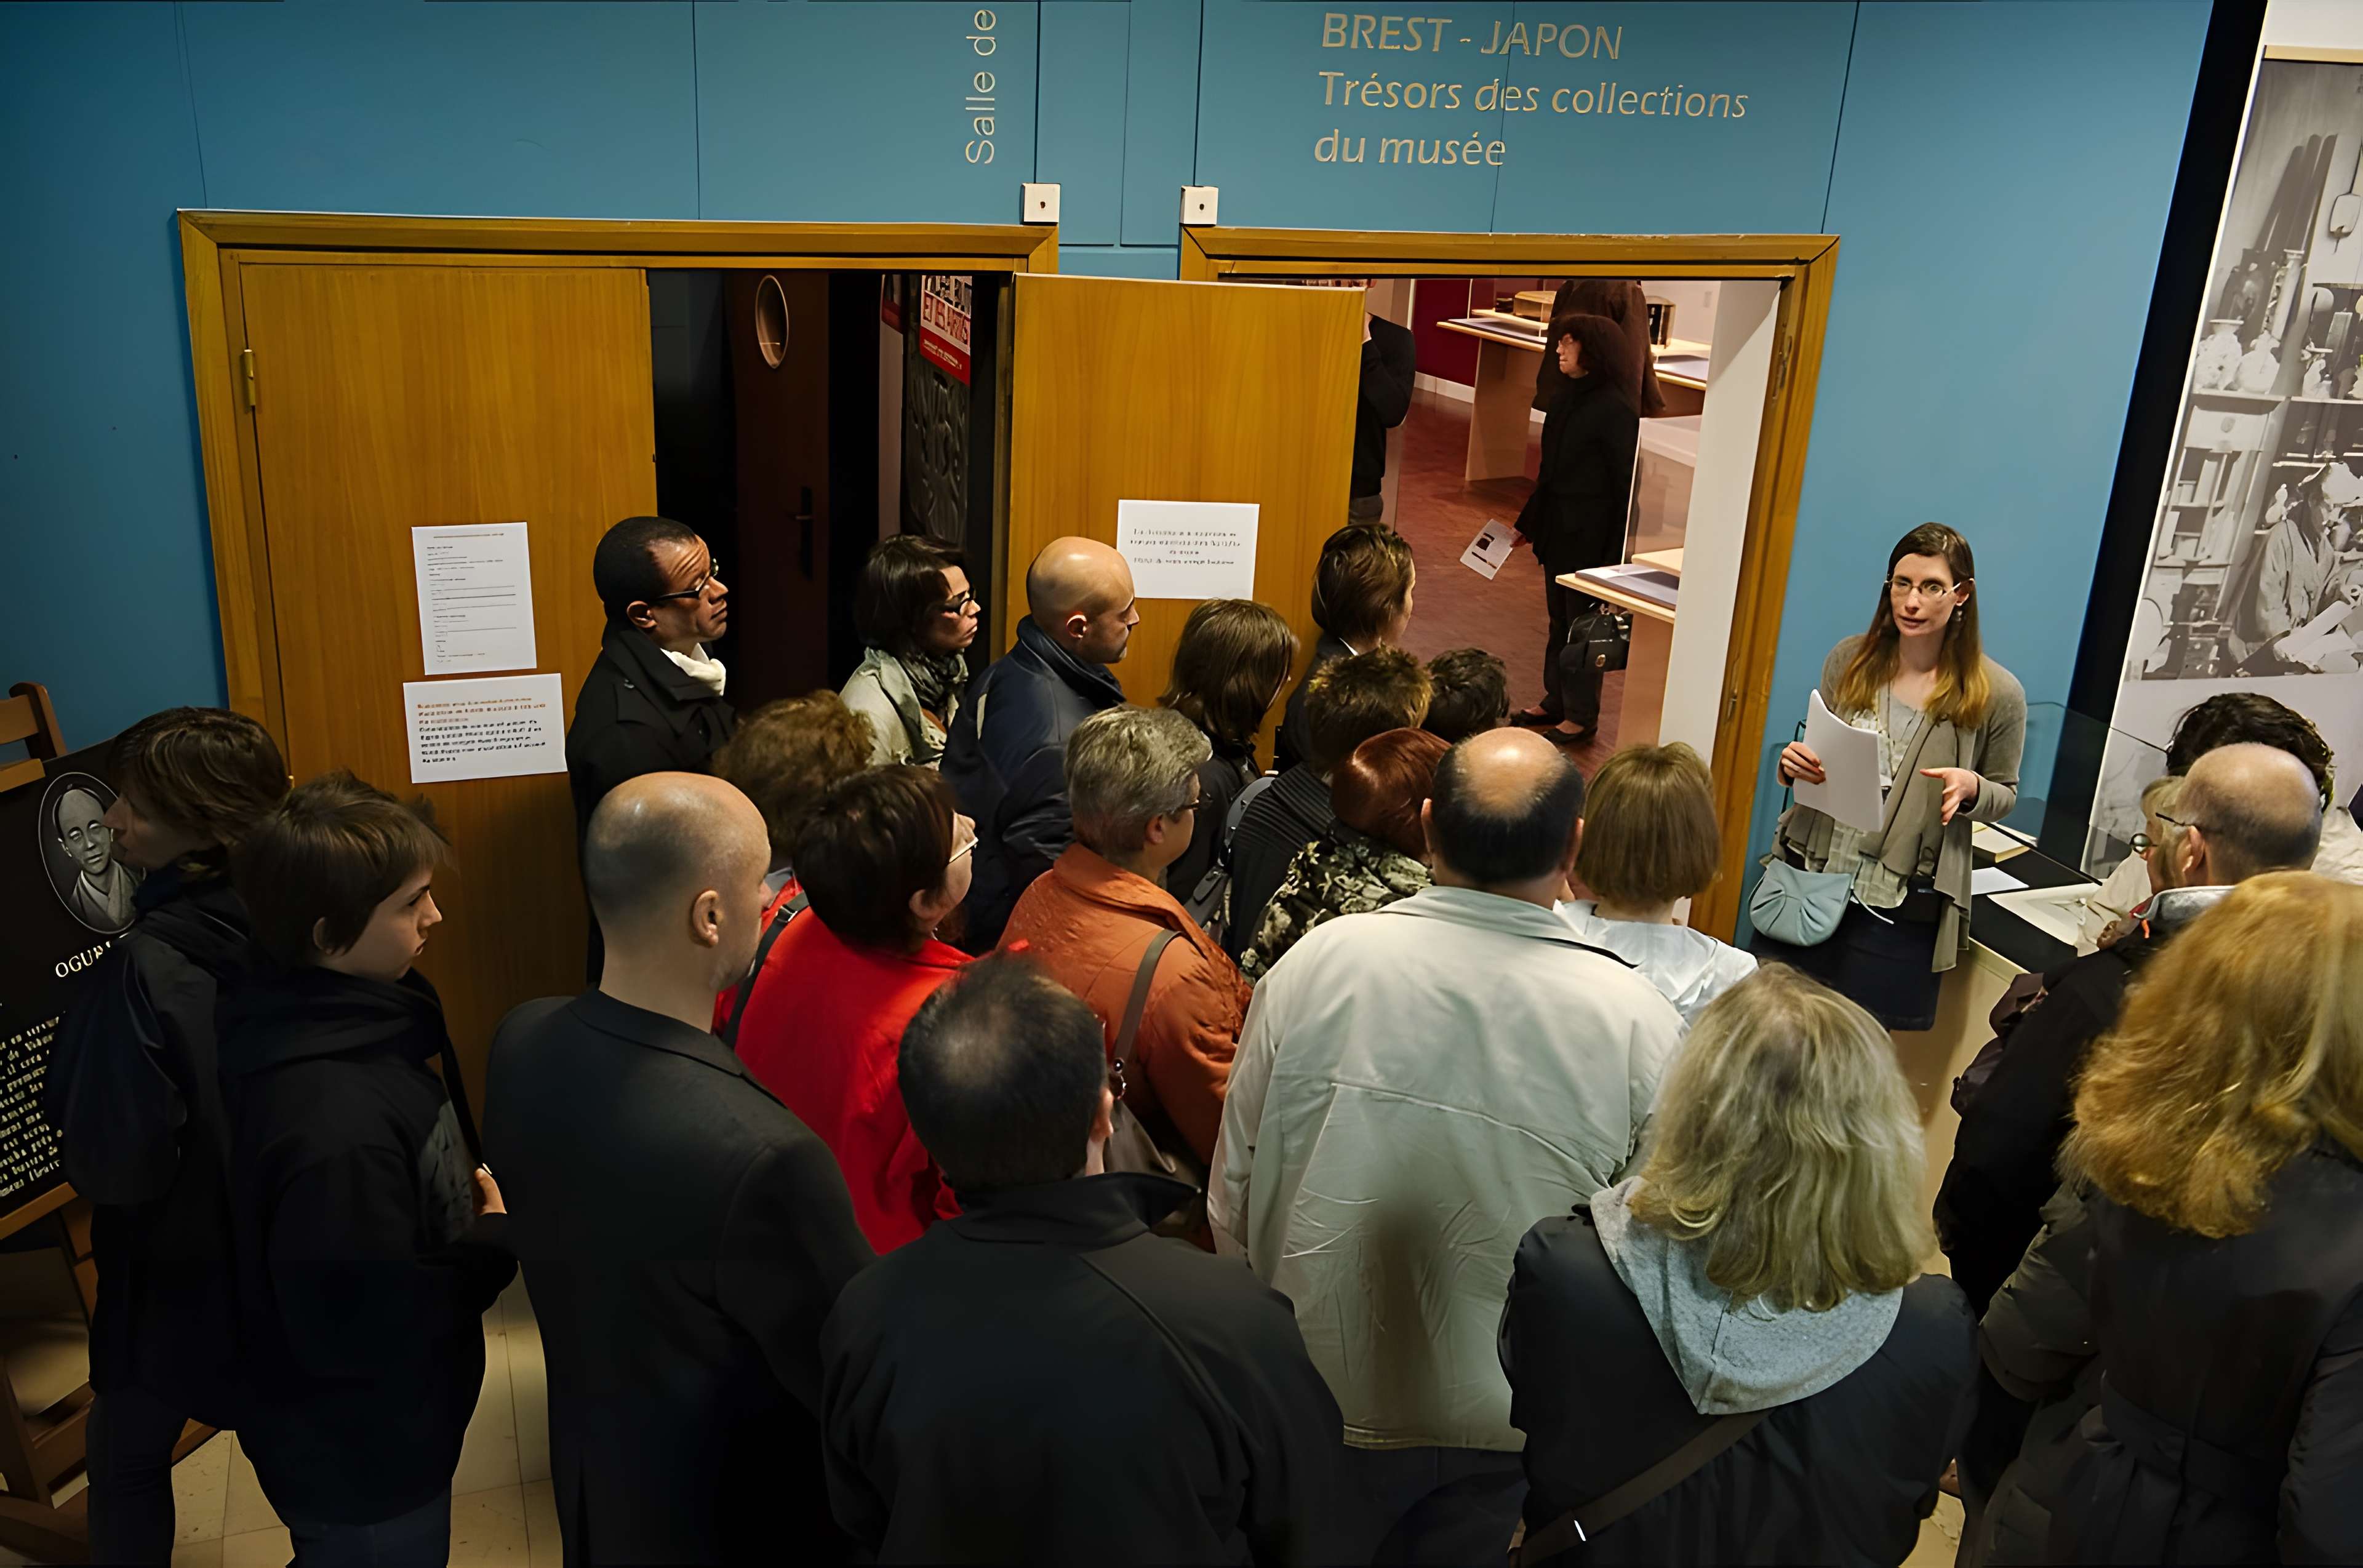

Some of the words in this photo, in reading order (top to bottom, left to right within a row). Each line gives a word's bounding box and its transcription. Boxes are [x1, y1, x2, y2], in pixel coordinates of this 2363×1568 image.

[965, 9, 996, 56] de
[1321, 12, 1452, 52] BREST
[1480, 20, 1623, 60] JAPON
[964, 71, 996, 164] Salle
[1319, 71, 1462, 109] Trésors
[1474, 78, 1540, 112] des
[1551, 82, 1749, 119] collections
[1314, 128, 1366, 163] du
[1378, 131, 1506, 166] musée
